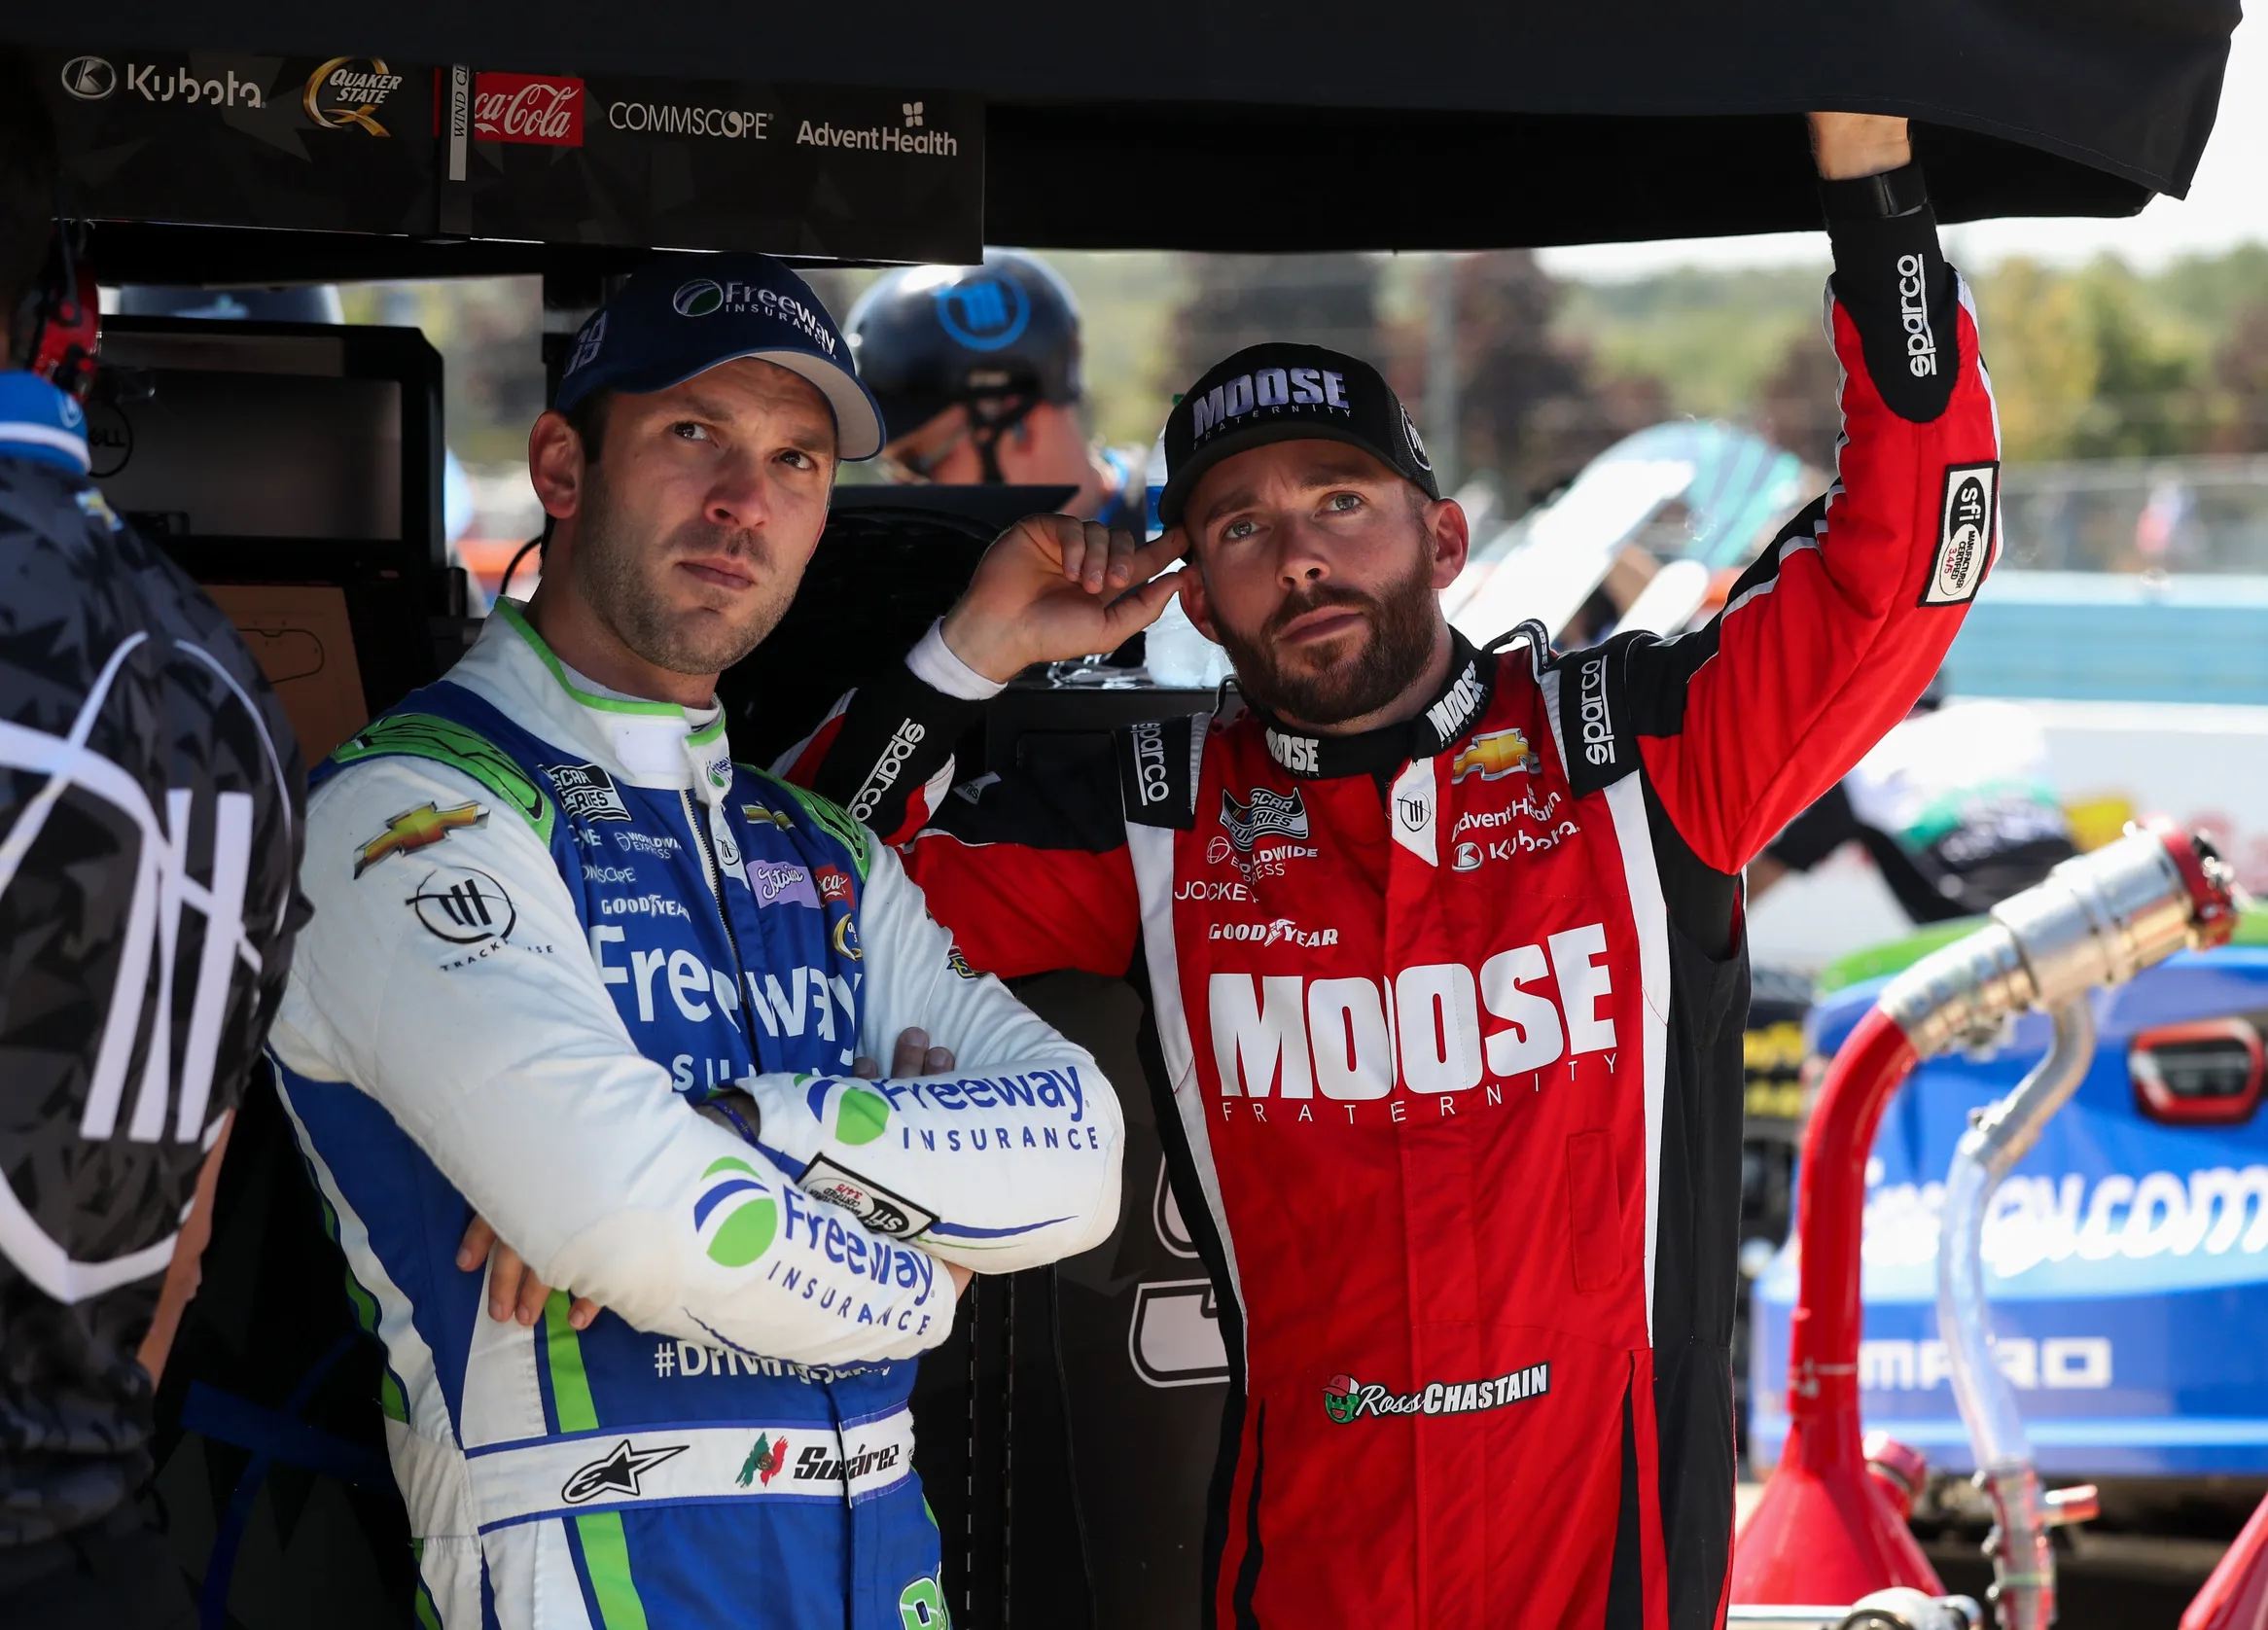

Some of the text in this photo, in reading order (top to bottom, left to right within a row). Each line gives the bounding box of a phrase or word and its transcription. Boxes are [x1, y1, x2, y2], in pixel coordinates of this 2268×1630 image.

[126, 63, 266, 109] Kubota
[329, 68, 403, 90] QUAKER
[336, 87, 390, 104] STATE
[454, 90, 468, 137] WIND
[475, 83, 580, 138] ca-Cola
[609, 102, 767, 140] COMMSCOPE
[726, 280, 835, 356] Freeway
[1896, 254, 1937, 377] sparco
[1192, 367, 1351, 440] MOOSE
[1192, 405, 1352, 450] FRATERNITY
[1959, 486, 1982, 522] sfi
[1950, 541, 1967, 581] CERTIFIED
[1955, 530, 1976, 589] MANUFACTURER
[1580, 659, 1615, 765] sparco
[849, 718, 926, 823] sparco
[1130, 723, 1170, 803] sparco
[1252, 792, 1293, 812] SCAR
[1254, 811, 1293, 828] RIES
[626, 832, 682, 849] WORLDWI
[601, 895, 691, 923] GOODYEA
[1174, 881, 1258, 904] JOCKE
[440, 939, 554, 972] TRACKSE
[1208, 923, 1617, 1101] MOOSE
[874, 1065, 1085, 1123] Freeway
[1222, 1053, 1617, 1125] FRATERNITY
[903, 1125, 1100, 1152] INSURANCE
[782, 1184, 935, 1306] Freeway
[766, 1259, 932, 1337] INSURANCE
[1355, 1364, 1547, 1416] Ross CHASTAIN
